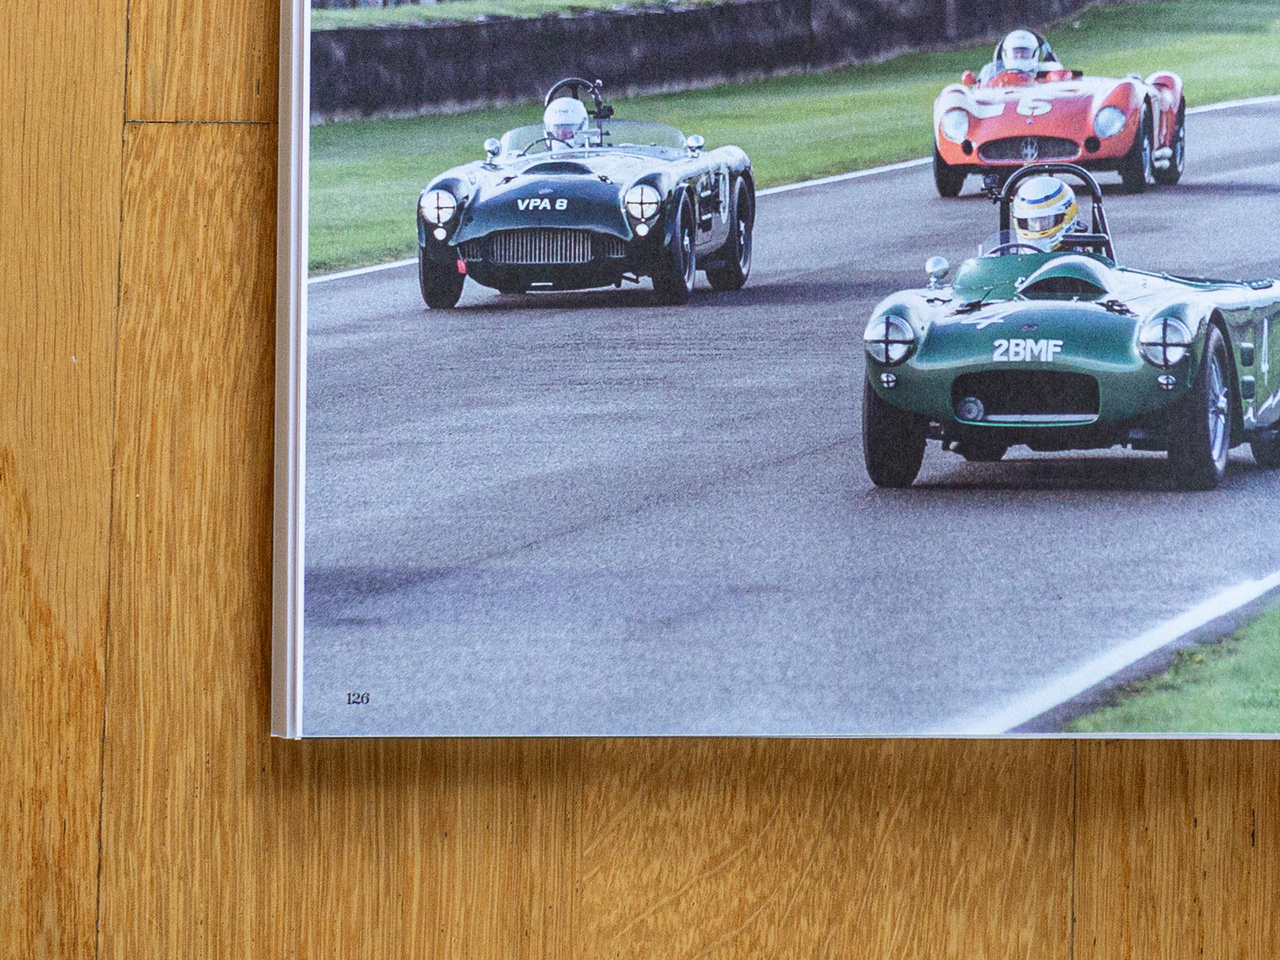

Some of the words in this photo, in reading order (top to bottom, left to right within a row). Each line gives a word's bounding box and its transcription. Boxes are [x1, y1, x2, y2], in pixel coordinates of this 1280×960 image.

[517, 198, 551, 211] VPA
[555, 198, 568, 211] 8
[992, 338, 1064, 362] 2BMF
[347, 692, 370, 705] 126
